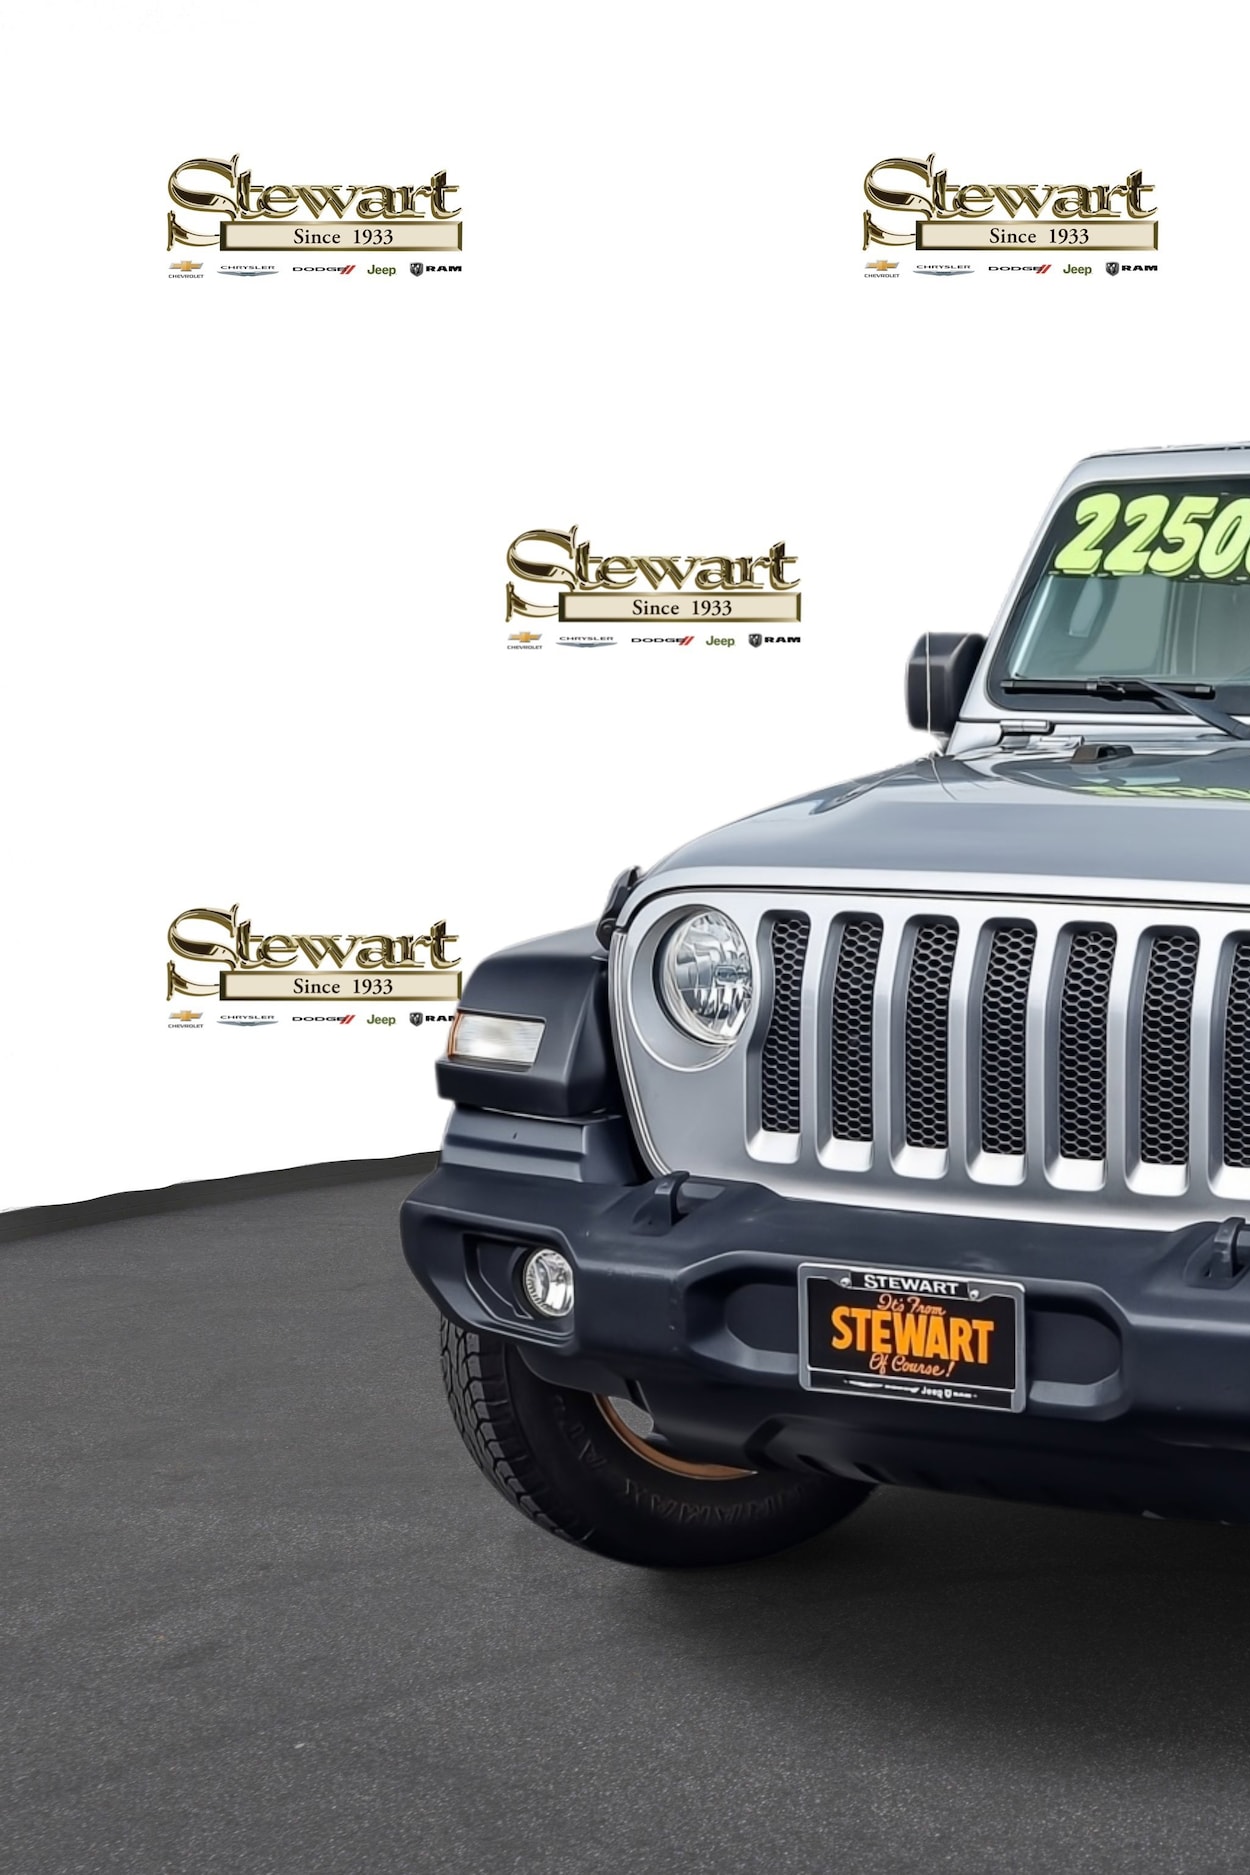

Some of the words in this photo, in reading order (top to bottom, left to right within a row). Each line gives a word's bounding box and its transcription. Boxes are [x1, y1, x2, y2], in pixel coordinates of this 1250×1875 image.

[167, 153, 463, 251] Stewart
[863, 152, 1159, 250] Stewart
[293, 228, 340, 246] Since
[353, 229, 394, 246] 1933
[989, 227, 1036, 245] Since
[1049, 228, 1090, 245] 1933
[367, 264, 396, 276] Jeep
[1063, 263, 1092, 275] Jeep
[505, 524, 801, 622] Stewart
[631, 599, 678, 617] Since
[691, 600, 732, 617] 1933
[705, 635, 734, 647] Jeep
[167, 903, 463, 1001] Stewart
[293, 978, 340, 996] Since
[353, 979, 394, 996] 1933
[367, 1014, 396, 1026] Jeep
[864, 1274, 959, 1295] STEWART
[877, 1293, 904, 1311] It's
[908, 1296, 947, 1316] From
[831, 1306, 994, 1364] STEWART
[869, 1353, 888, 1375] Of
